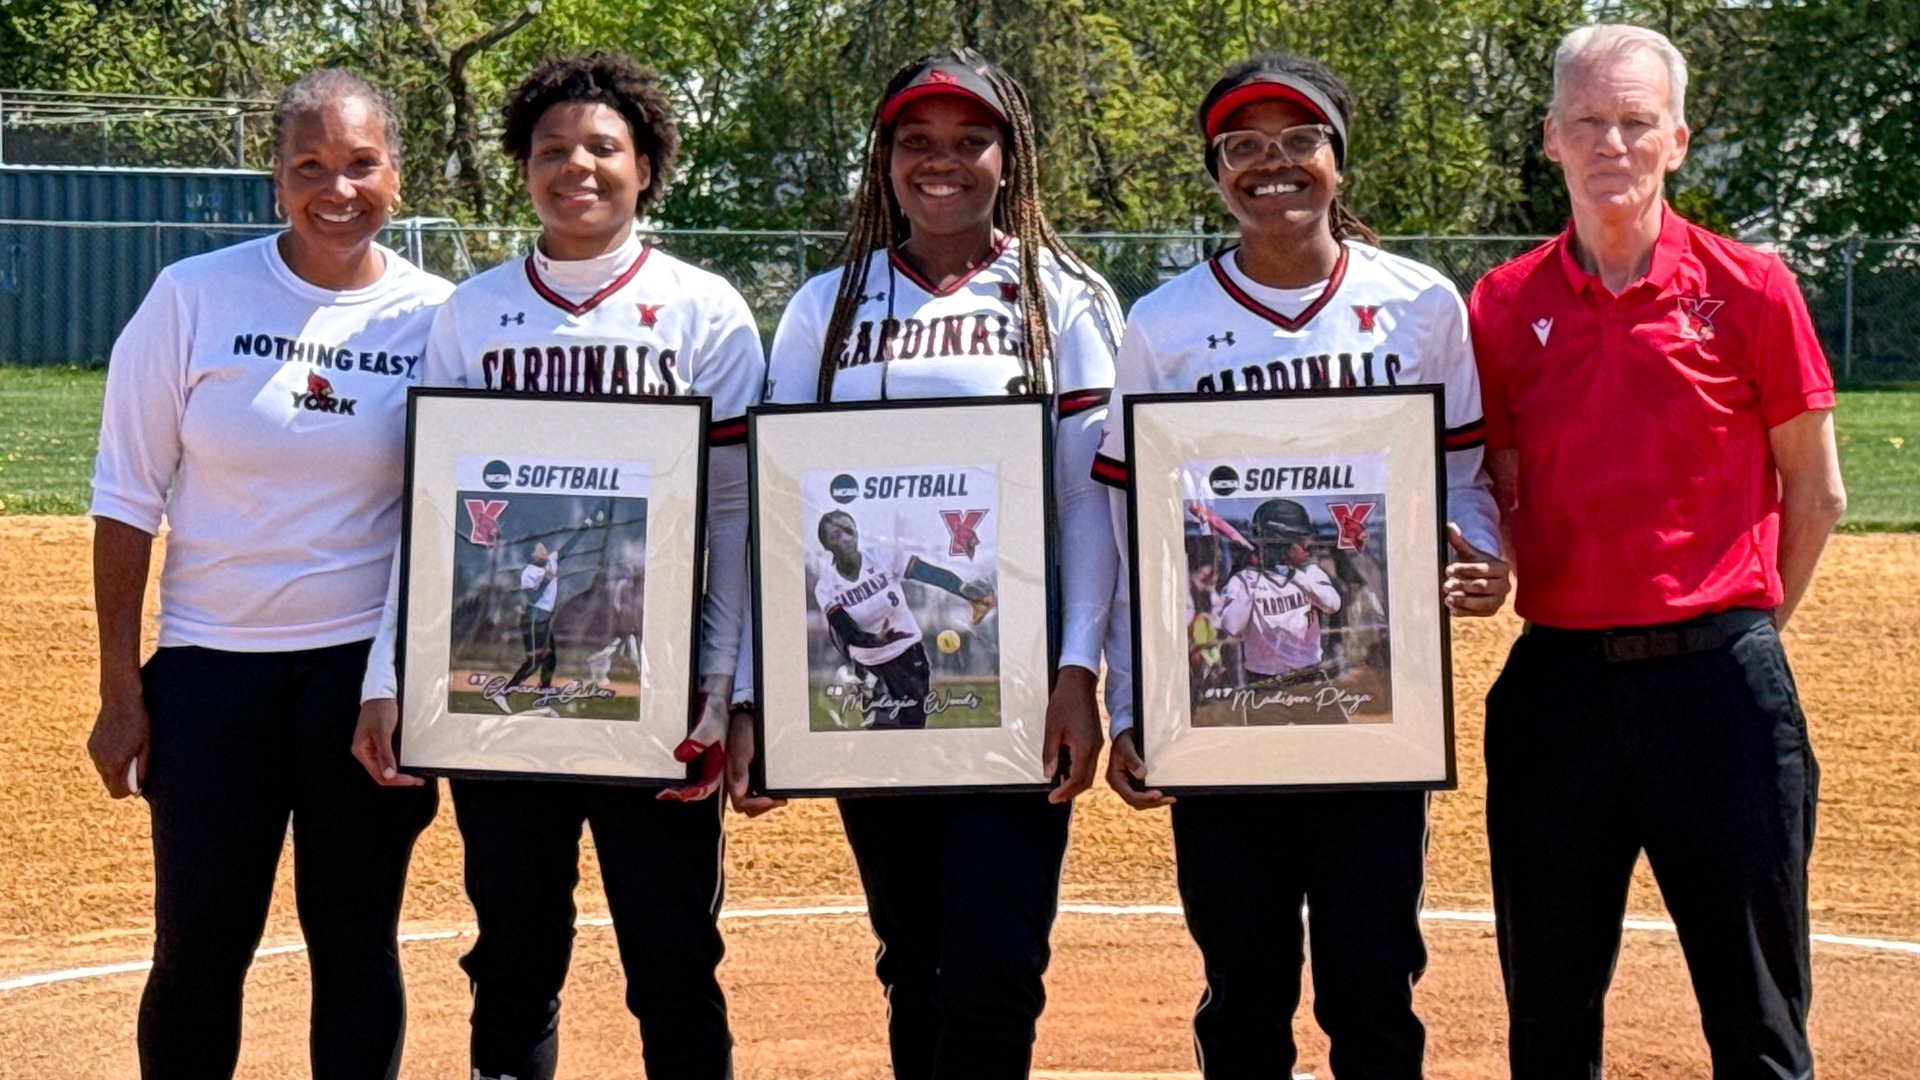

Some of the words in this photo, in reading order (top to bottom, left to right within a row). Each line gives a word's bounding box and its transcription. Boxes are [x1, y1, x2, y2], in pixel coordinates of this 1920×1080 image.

[233, 333, 354, 372] NOTHING
[359, 351, 419, 376] EASY
[836, 313, 1022, 370] ARDINAL
[482, 344, 679, 396] CARDINALS
[290, 391, 358, 416] YORK
[515, 464, 620, 491] SOFTBALL
[863, 473, 969, 499] SOFTBALL
[1244, 465, 1355, 491] SOFTBALL
[887, 591, 900, 608] 8
[1231, 688, 1314, 712] Madison
